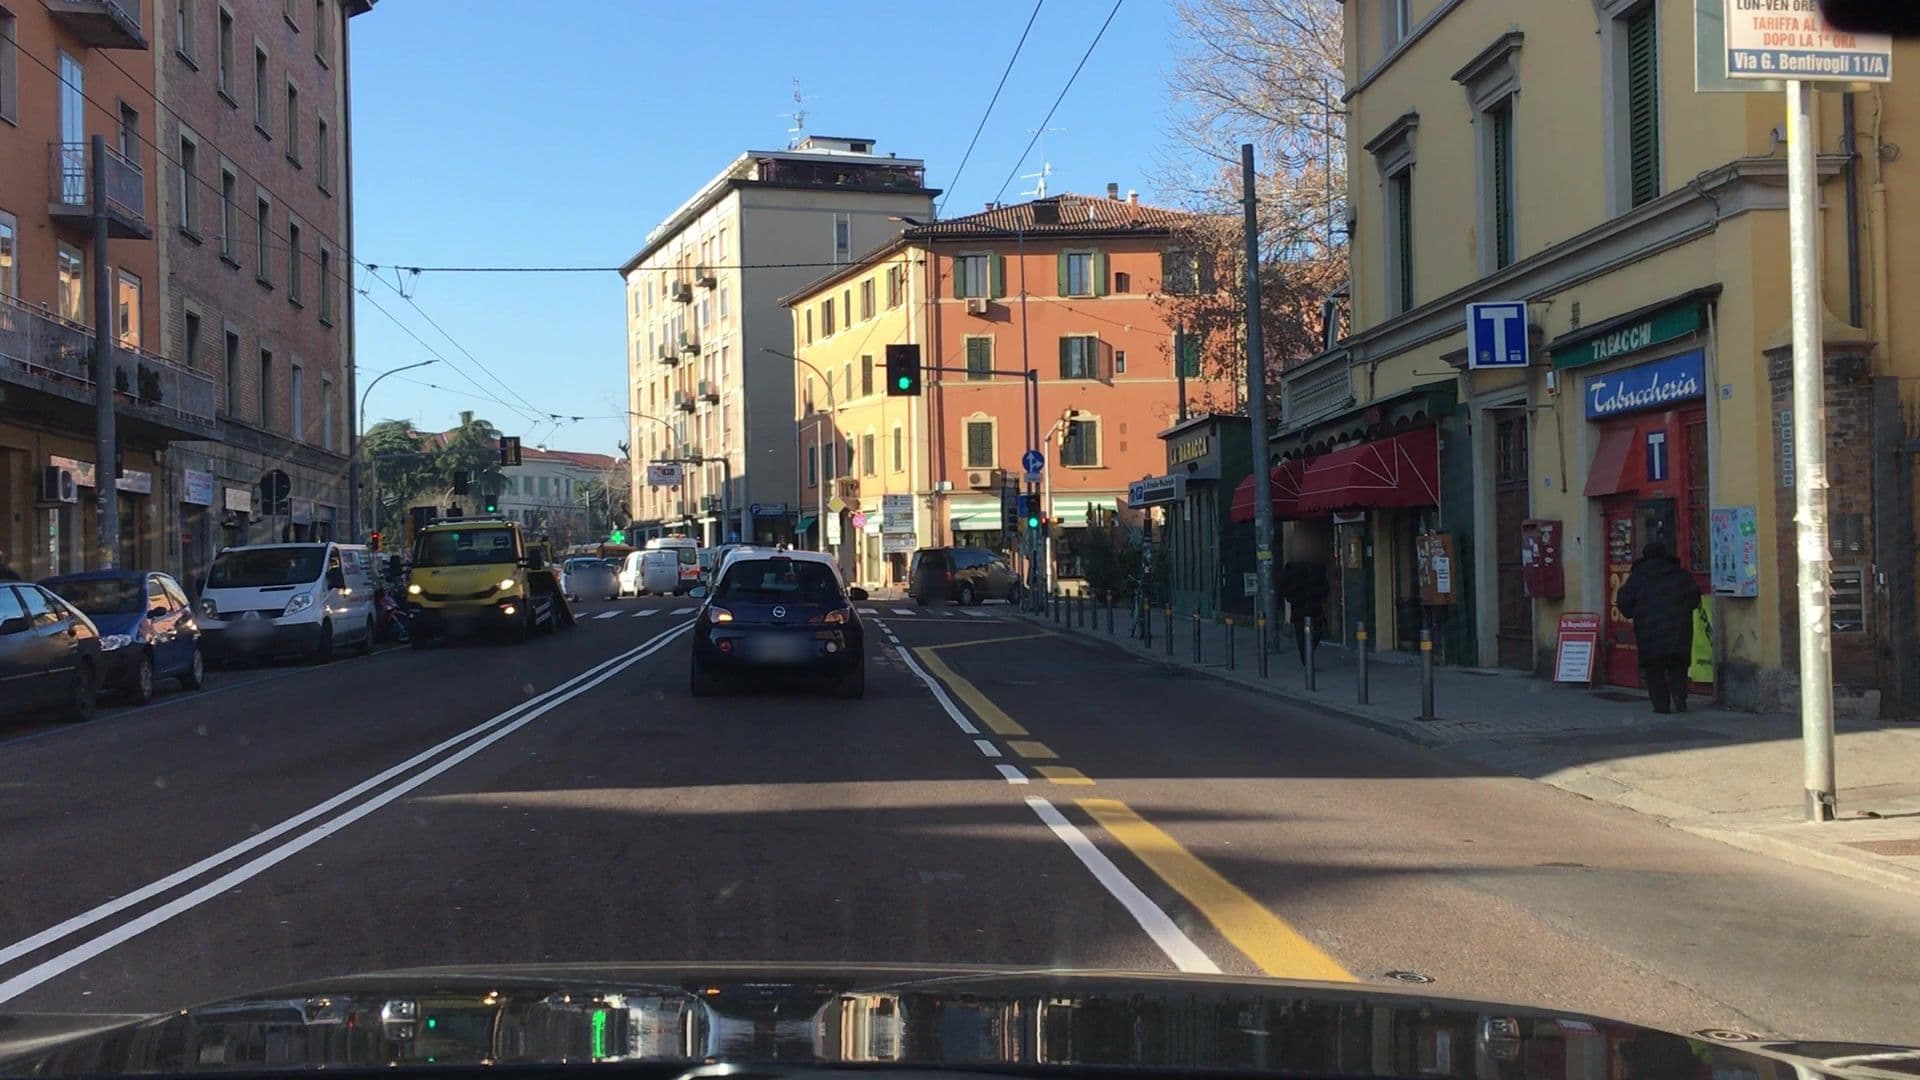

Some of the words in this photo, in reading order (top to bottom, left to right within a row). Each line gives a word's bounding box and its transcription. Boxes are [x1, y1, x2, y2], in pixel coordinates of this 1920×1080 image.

[1736, 0, 1792, 11] LUN-VEN
[1793, 0, 1815, 12] ORE
[1752, 16, 1799, 31] TARIFFA
[1803, 18, 1817, 32] AL
[1763, 33, 1795, 47] DOPO
[1800, 34, 1813, 48] LA
[1833, 36, 1856, 49] ORA
[1734, 52, 1757, 69] Via
[1761, 53, 1775, 70] G.
[1779, 53, 1849, 75] Bentivogli
[1853, 56, 1884, 73] 11/A
[1480, 307, 1518, 361] T
[1592, 322, 1652, 359] TABACCHI
[1591, 371, 1698, 413] Tabaccheria
[1648, 433, 1664, 479] T
